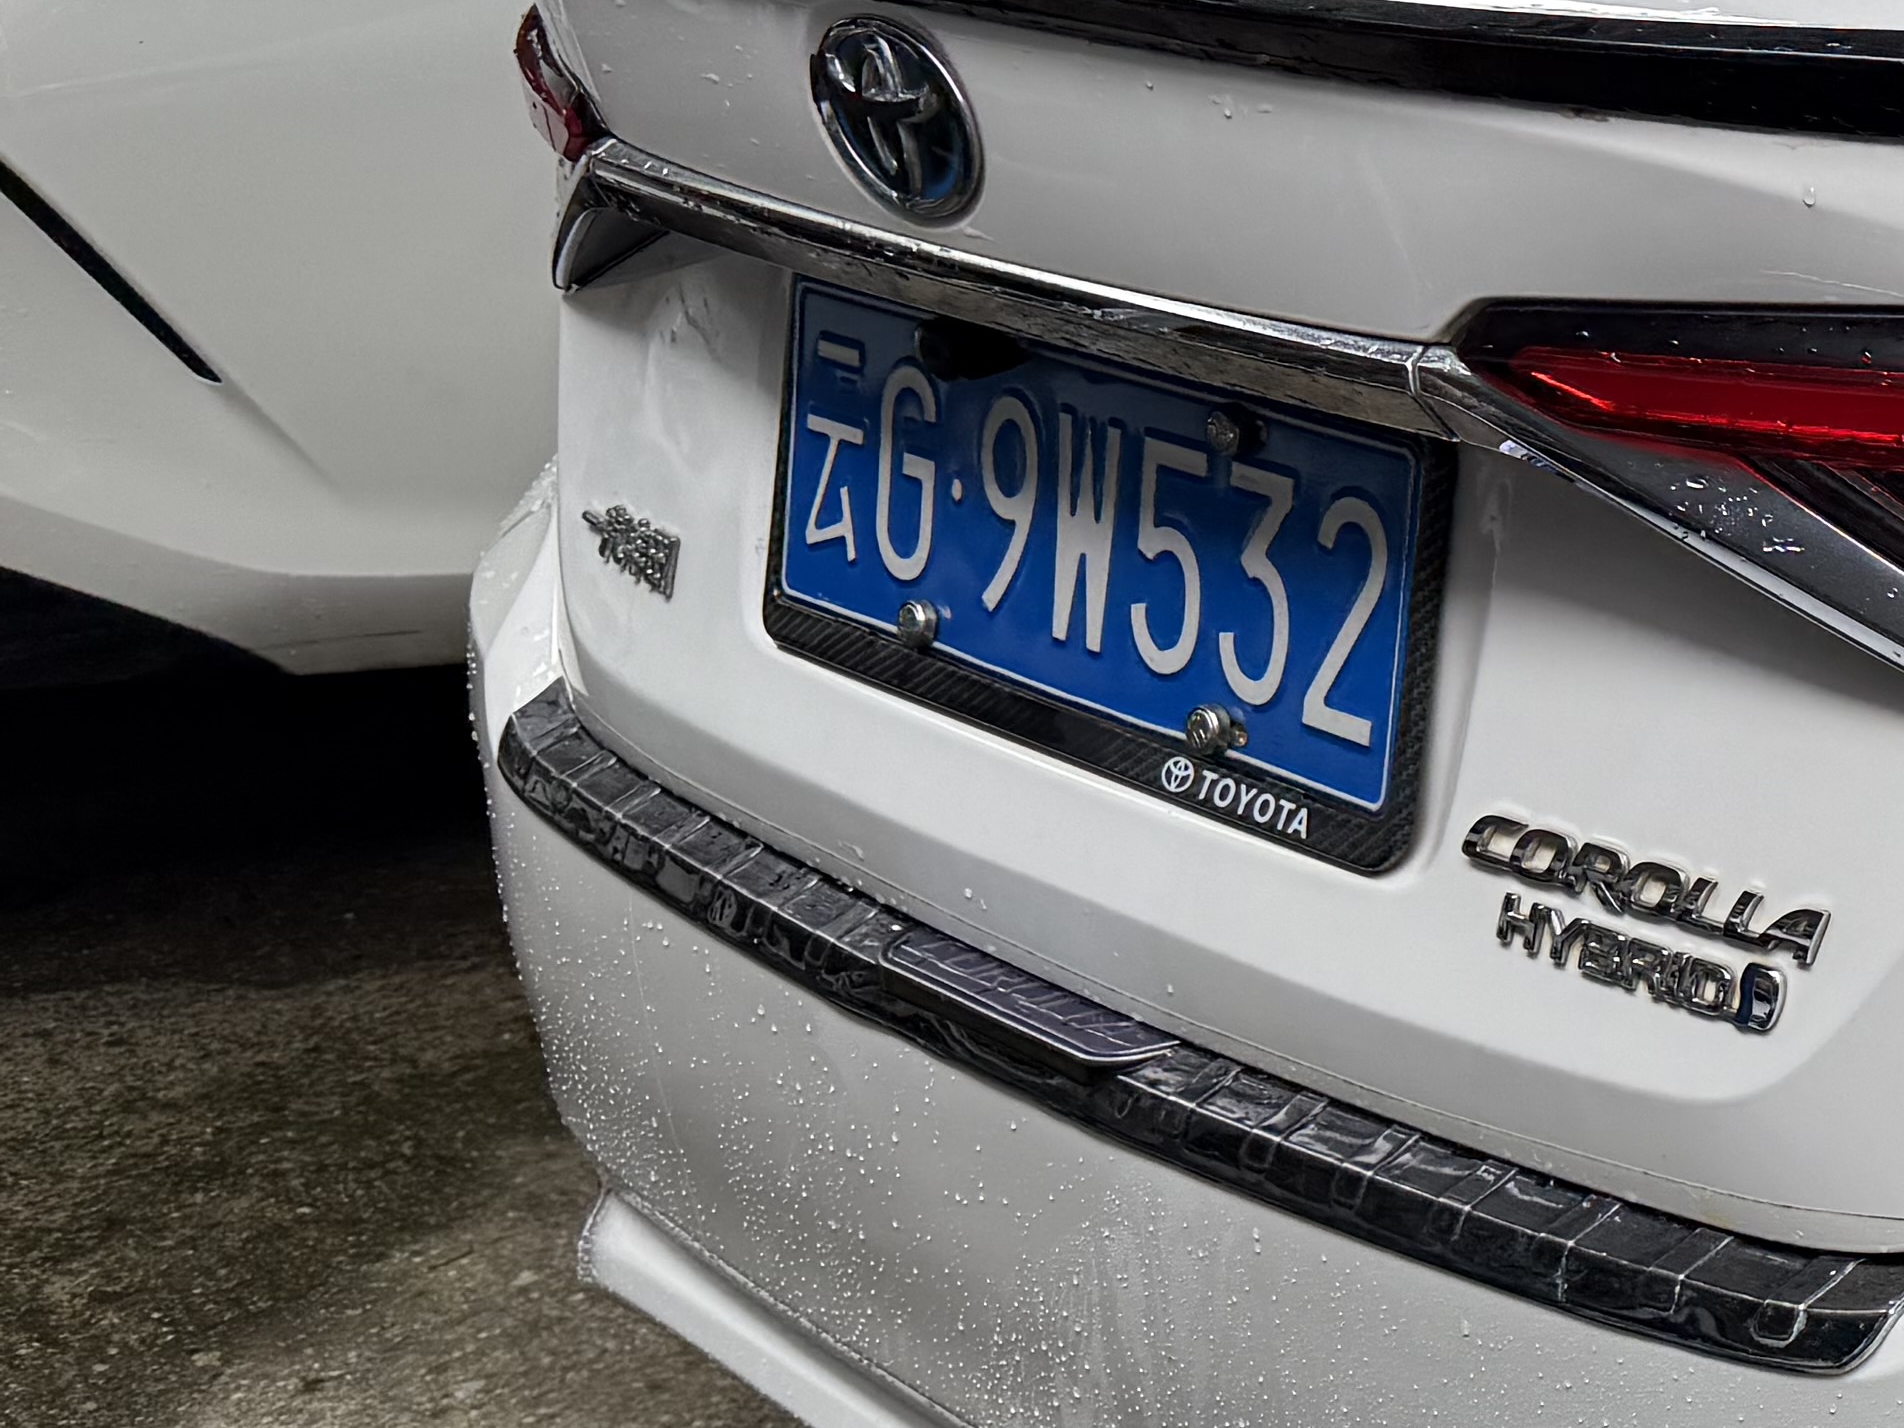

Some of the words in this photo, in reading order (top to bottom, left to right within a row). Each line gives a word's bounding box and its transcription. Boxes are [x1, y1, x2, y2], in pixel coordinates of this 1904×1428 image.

[805, 331, 1389, 748] 云G·9W532
[1201, 769, 1311, 840] TOYOTA
[1461, 813, 1832, 968] COROLLA
[1496, 890, 1738, 1018] HYBRID
